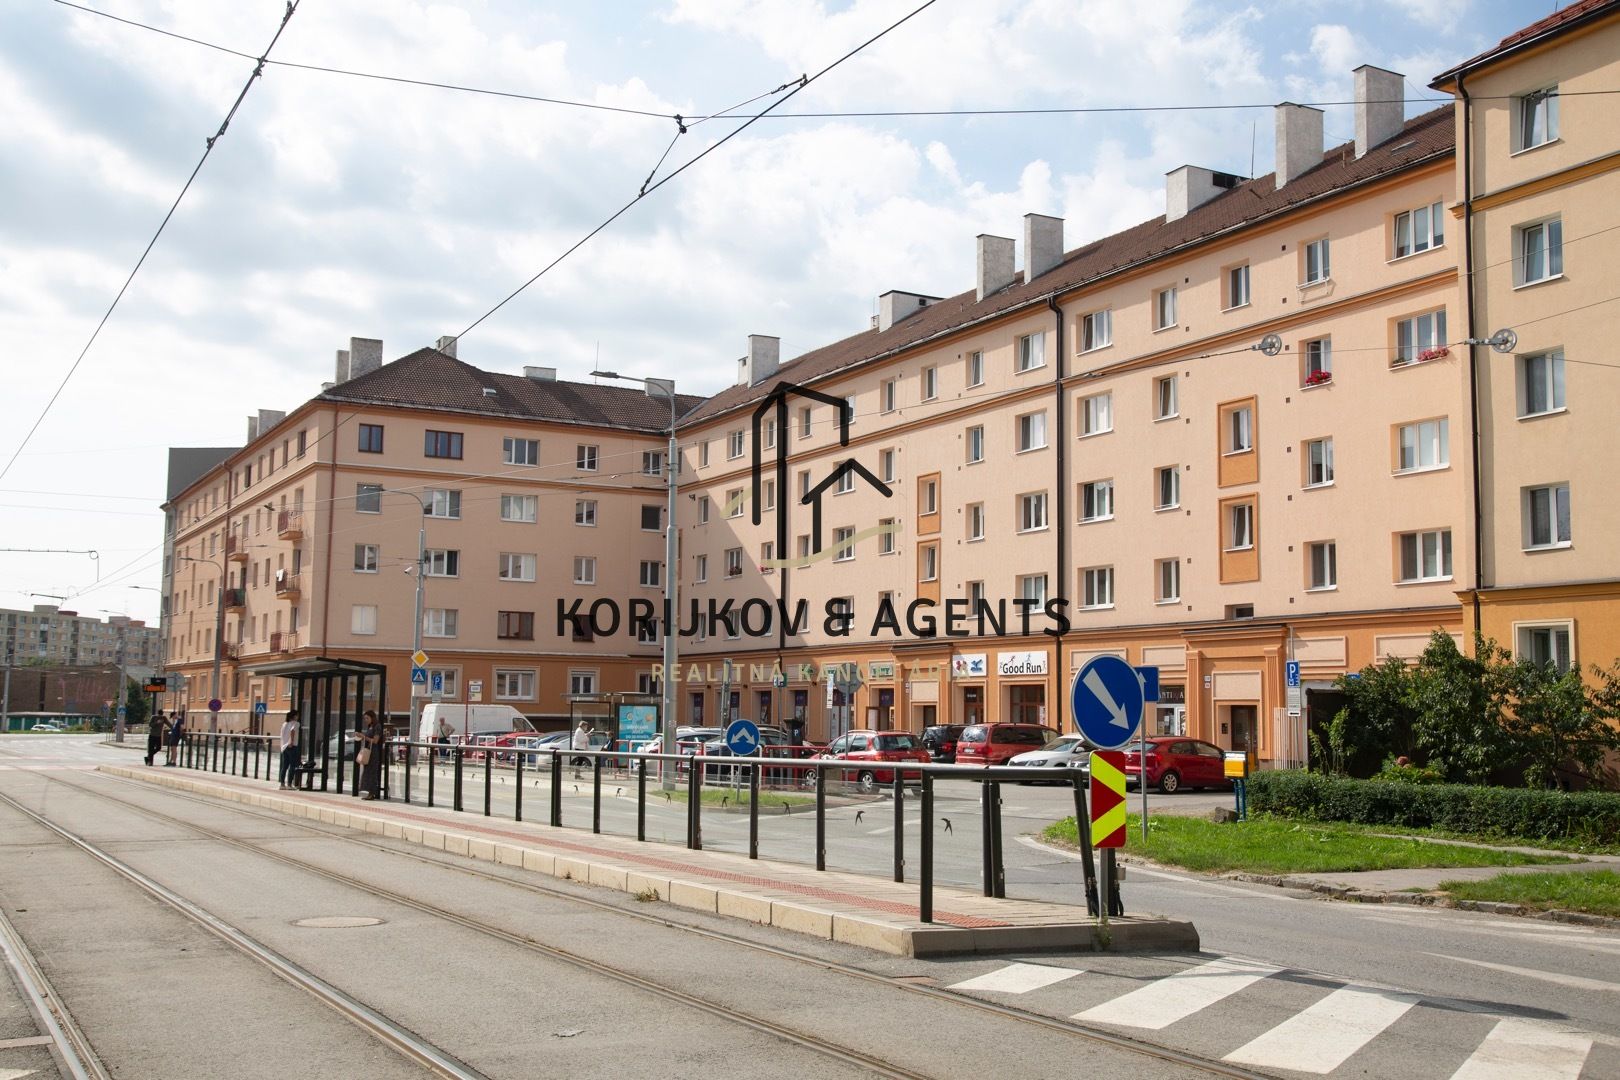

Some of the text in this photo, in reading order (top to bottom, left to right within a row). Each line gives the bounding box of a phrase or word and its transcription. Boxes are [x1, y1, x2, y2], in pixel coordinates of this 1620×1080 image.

[1002, 662, 1042, 674] Good Run
[1289, 663, 1296, 679] P
